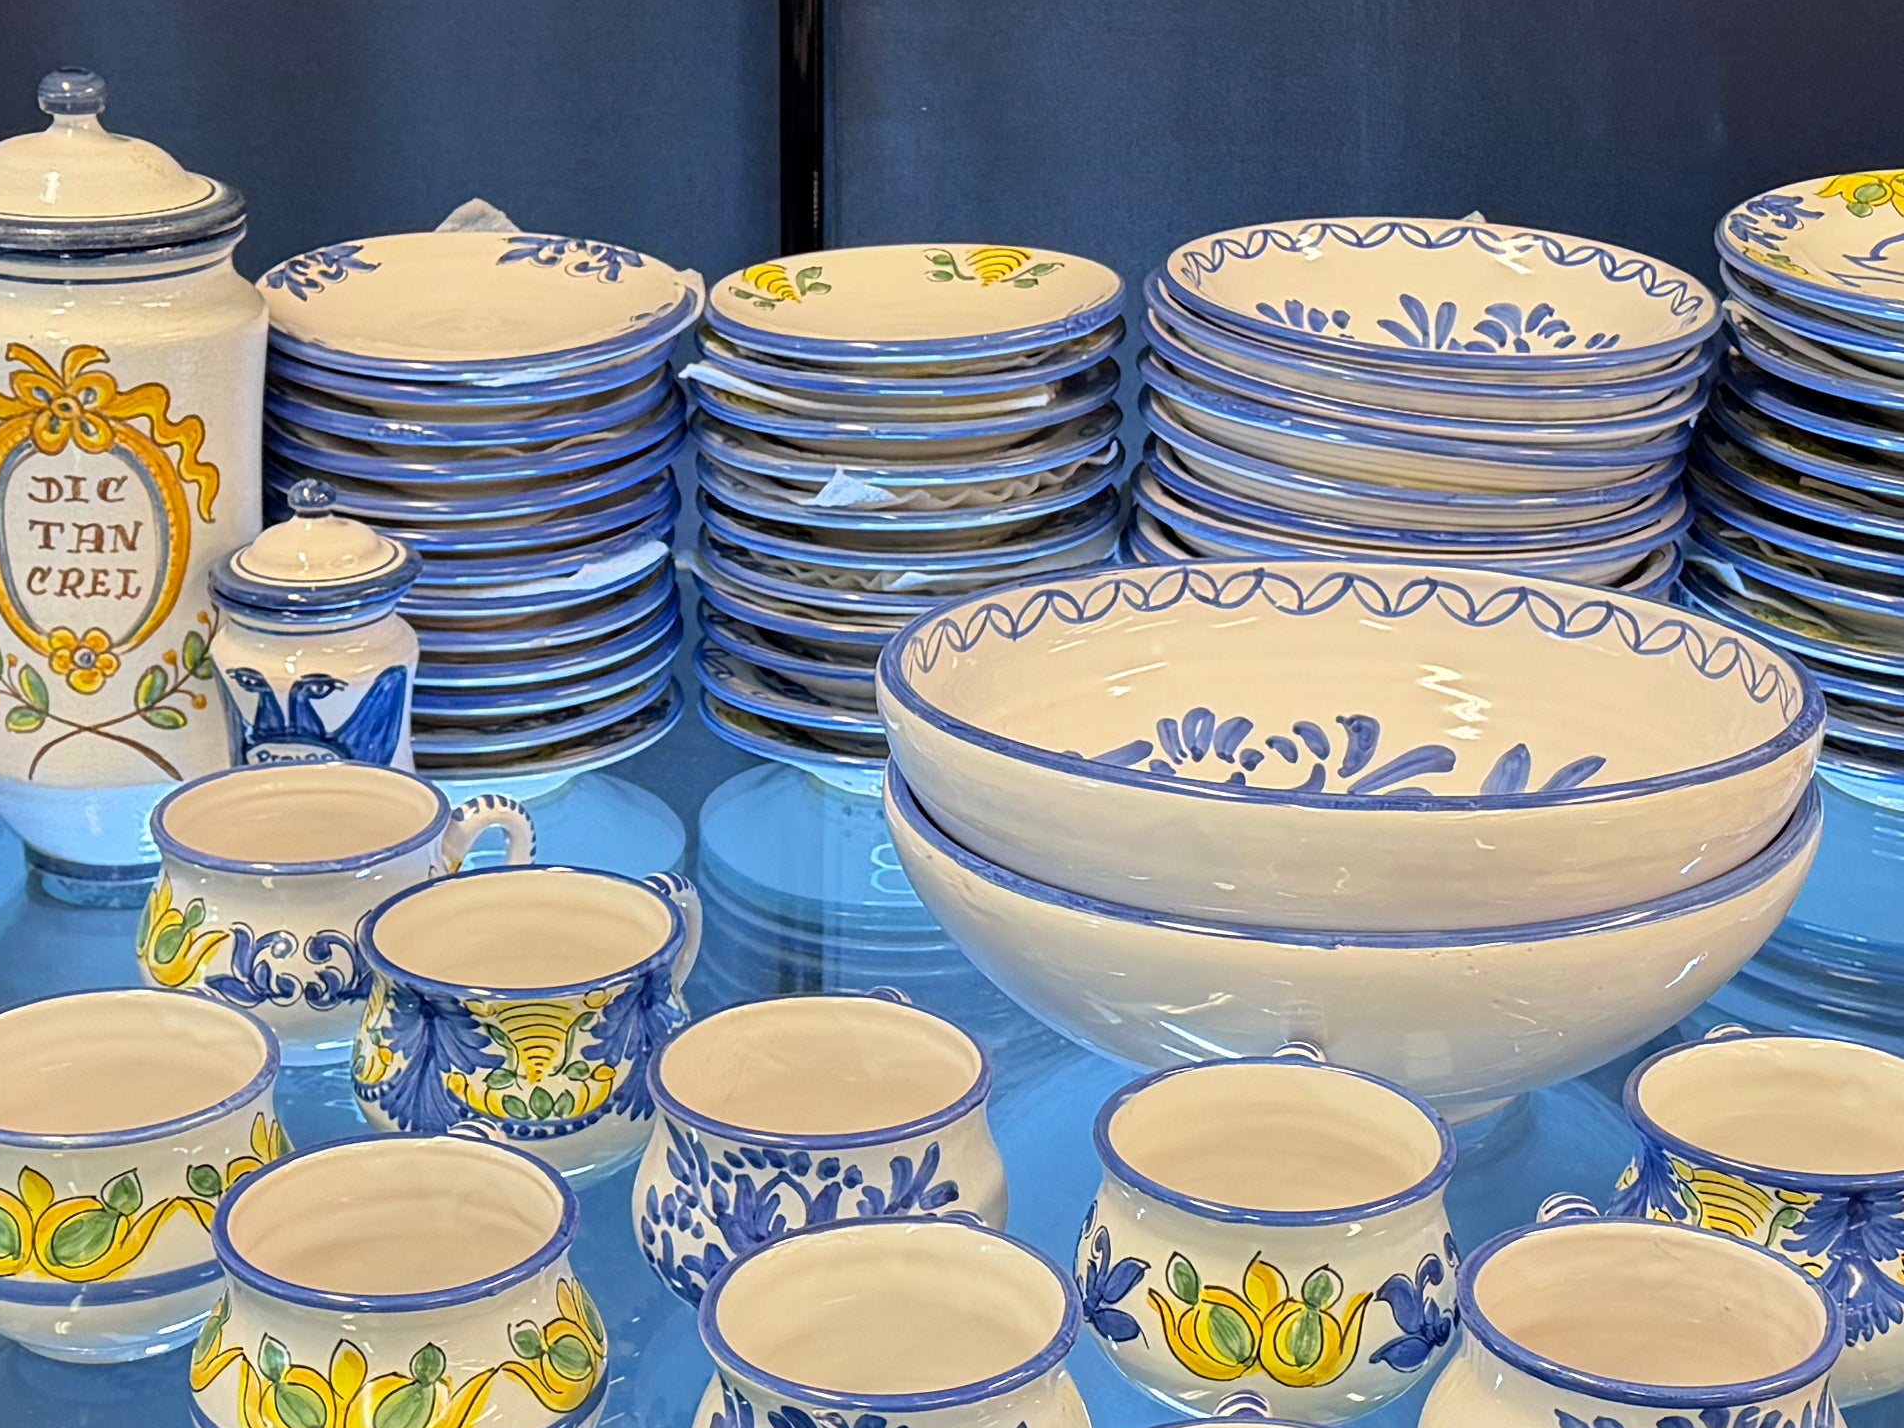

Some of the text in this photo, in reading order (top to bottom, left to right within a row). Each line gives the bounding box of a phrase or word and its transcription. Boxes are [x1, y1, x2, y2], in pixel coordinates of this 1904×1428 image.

[27, 475, 128, 503] DIC
[28, 519, 144, 554] TAN
[26, 565, 142, 600] CREL
